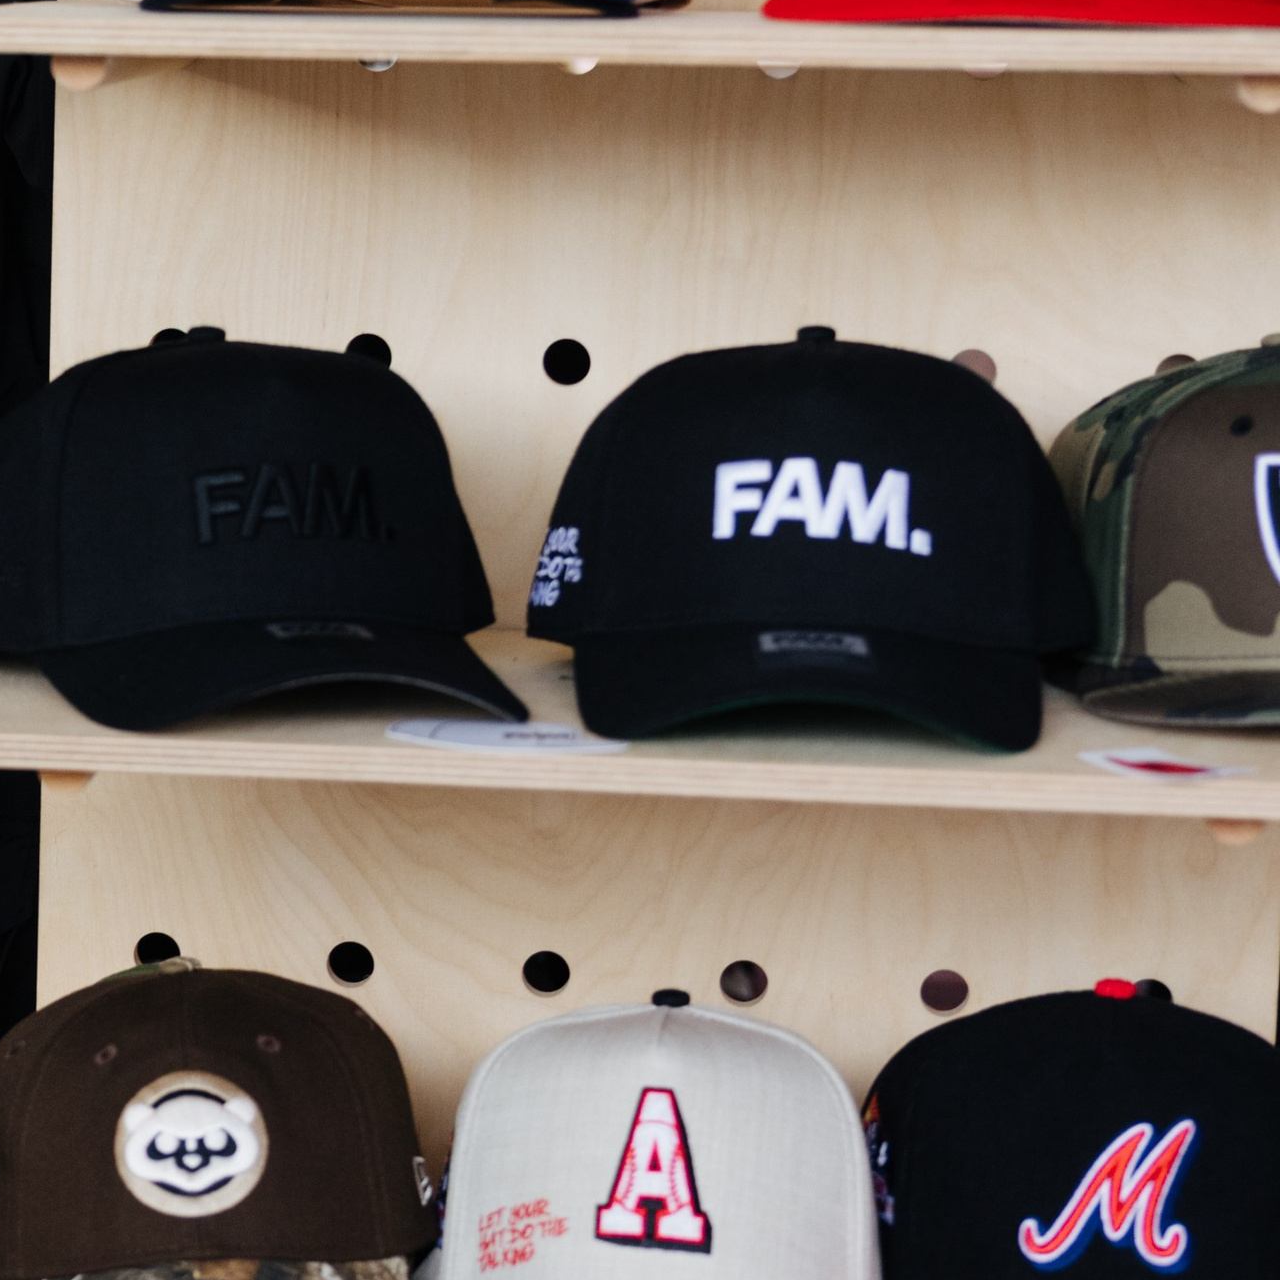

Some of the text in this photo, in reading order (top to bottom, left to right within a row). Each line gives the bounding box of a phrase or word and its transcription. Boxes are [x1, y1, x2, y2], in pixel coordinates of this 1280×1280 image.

[191, 461, 397, 545] FAM.
[710, 455, 933, 557] FAM.
[595, 1085, 714, 1254] A
